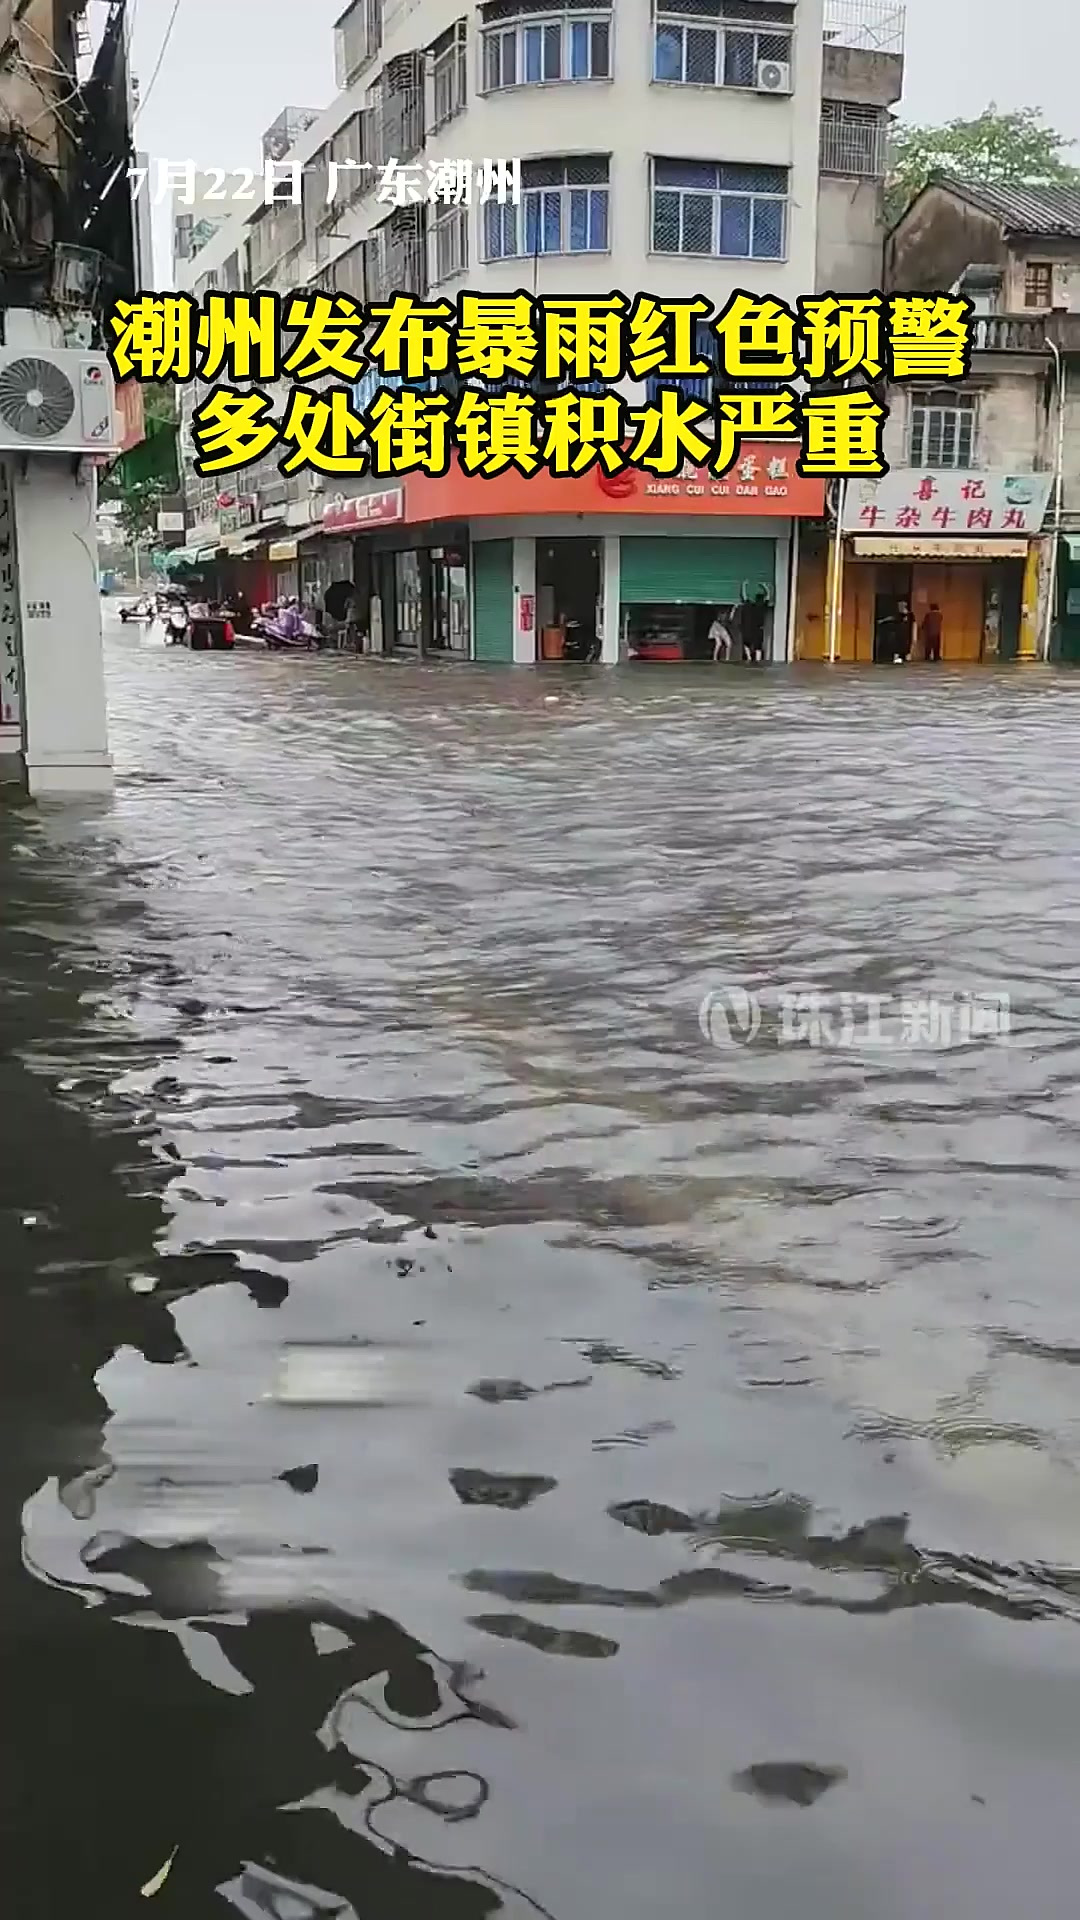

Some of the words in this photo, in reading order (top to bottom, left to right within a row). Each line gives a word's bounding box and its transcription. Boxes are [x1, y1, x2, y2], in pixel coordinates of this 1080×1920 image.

[646, 484, 680, 495] XIANG
[686, 485, 705, 495] CUI
[711, 485, 730, 495] CUI
[913, 475, 987, 501] 喜记
[859, 505, 1026, 529] 牛杂牛肉丸
